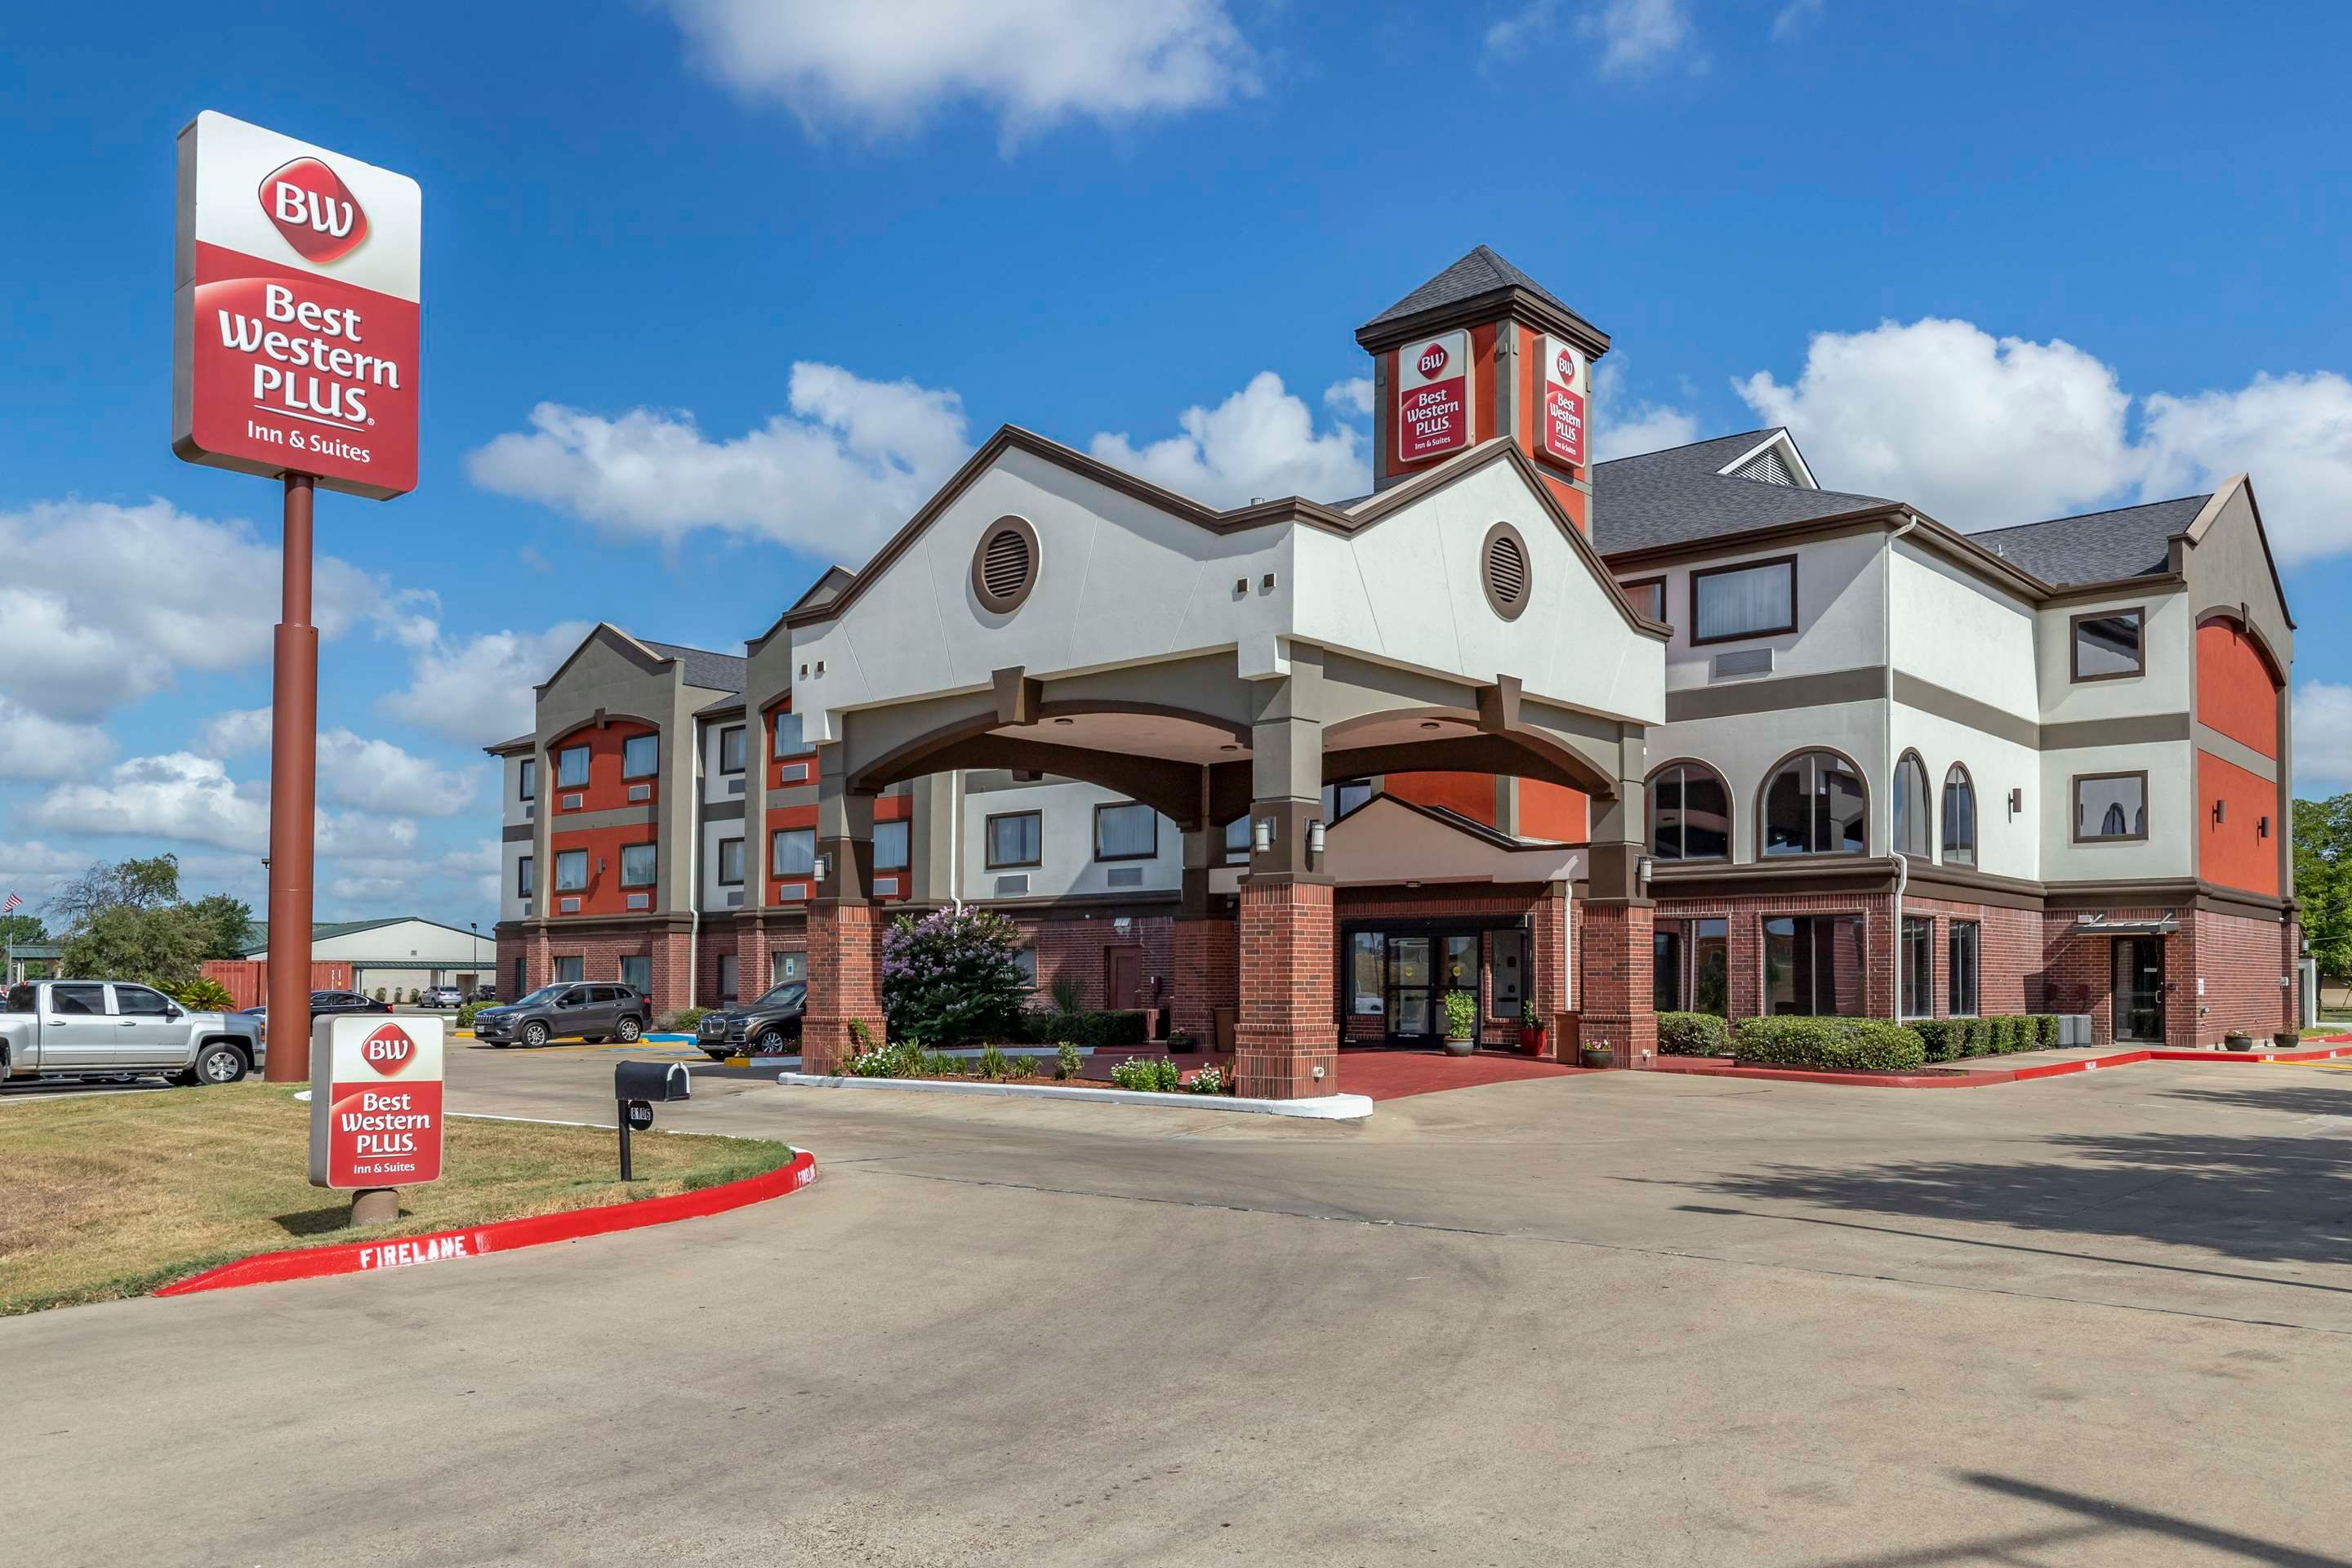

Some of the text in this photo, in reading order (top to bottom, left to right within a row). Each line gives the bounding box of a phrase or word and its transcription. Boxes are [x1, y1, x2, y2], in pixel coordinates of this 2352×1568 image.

[275, 180, 354, 238] BW
[265, 283, 362, 342] Best
[217, 309, 400, 390] Western
[1421, 351, 1444, 372] BW
[1559, 358, 1572, 376] BW
[1419, 389, 1447, 407] Best
[1557, 392, 1575, 412] Best
[1406, 400, 1459, 423] Western
[1550, 403, 1581, 429] Western
[247, 420, 371, 464] Inn & Suites
[1432, 436, 1451, 447] Suites
[369, 1040, 408, 1060] BW
[363, 1093, 412, 1111] Best
[341, 1112, 431, 1132] Western
[354, 1161, 416, 1174] Inn & Suites
[359, 1235, 467, 1268] FIRELANE
